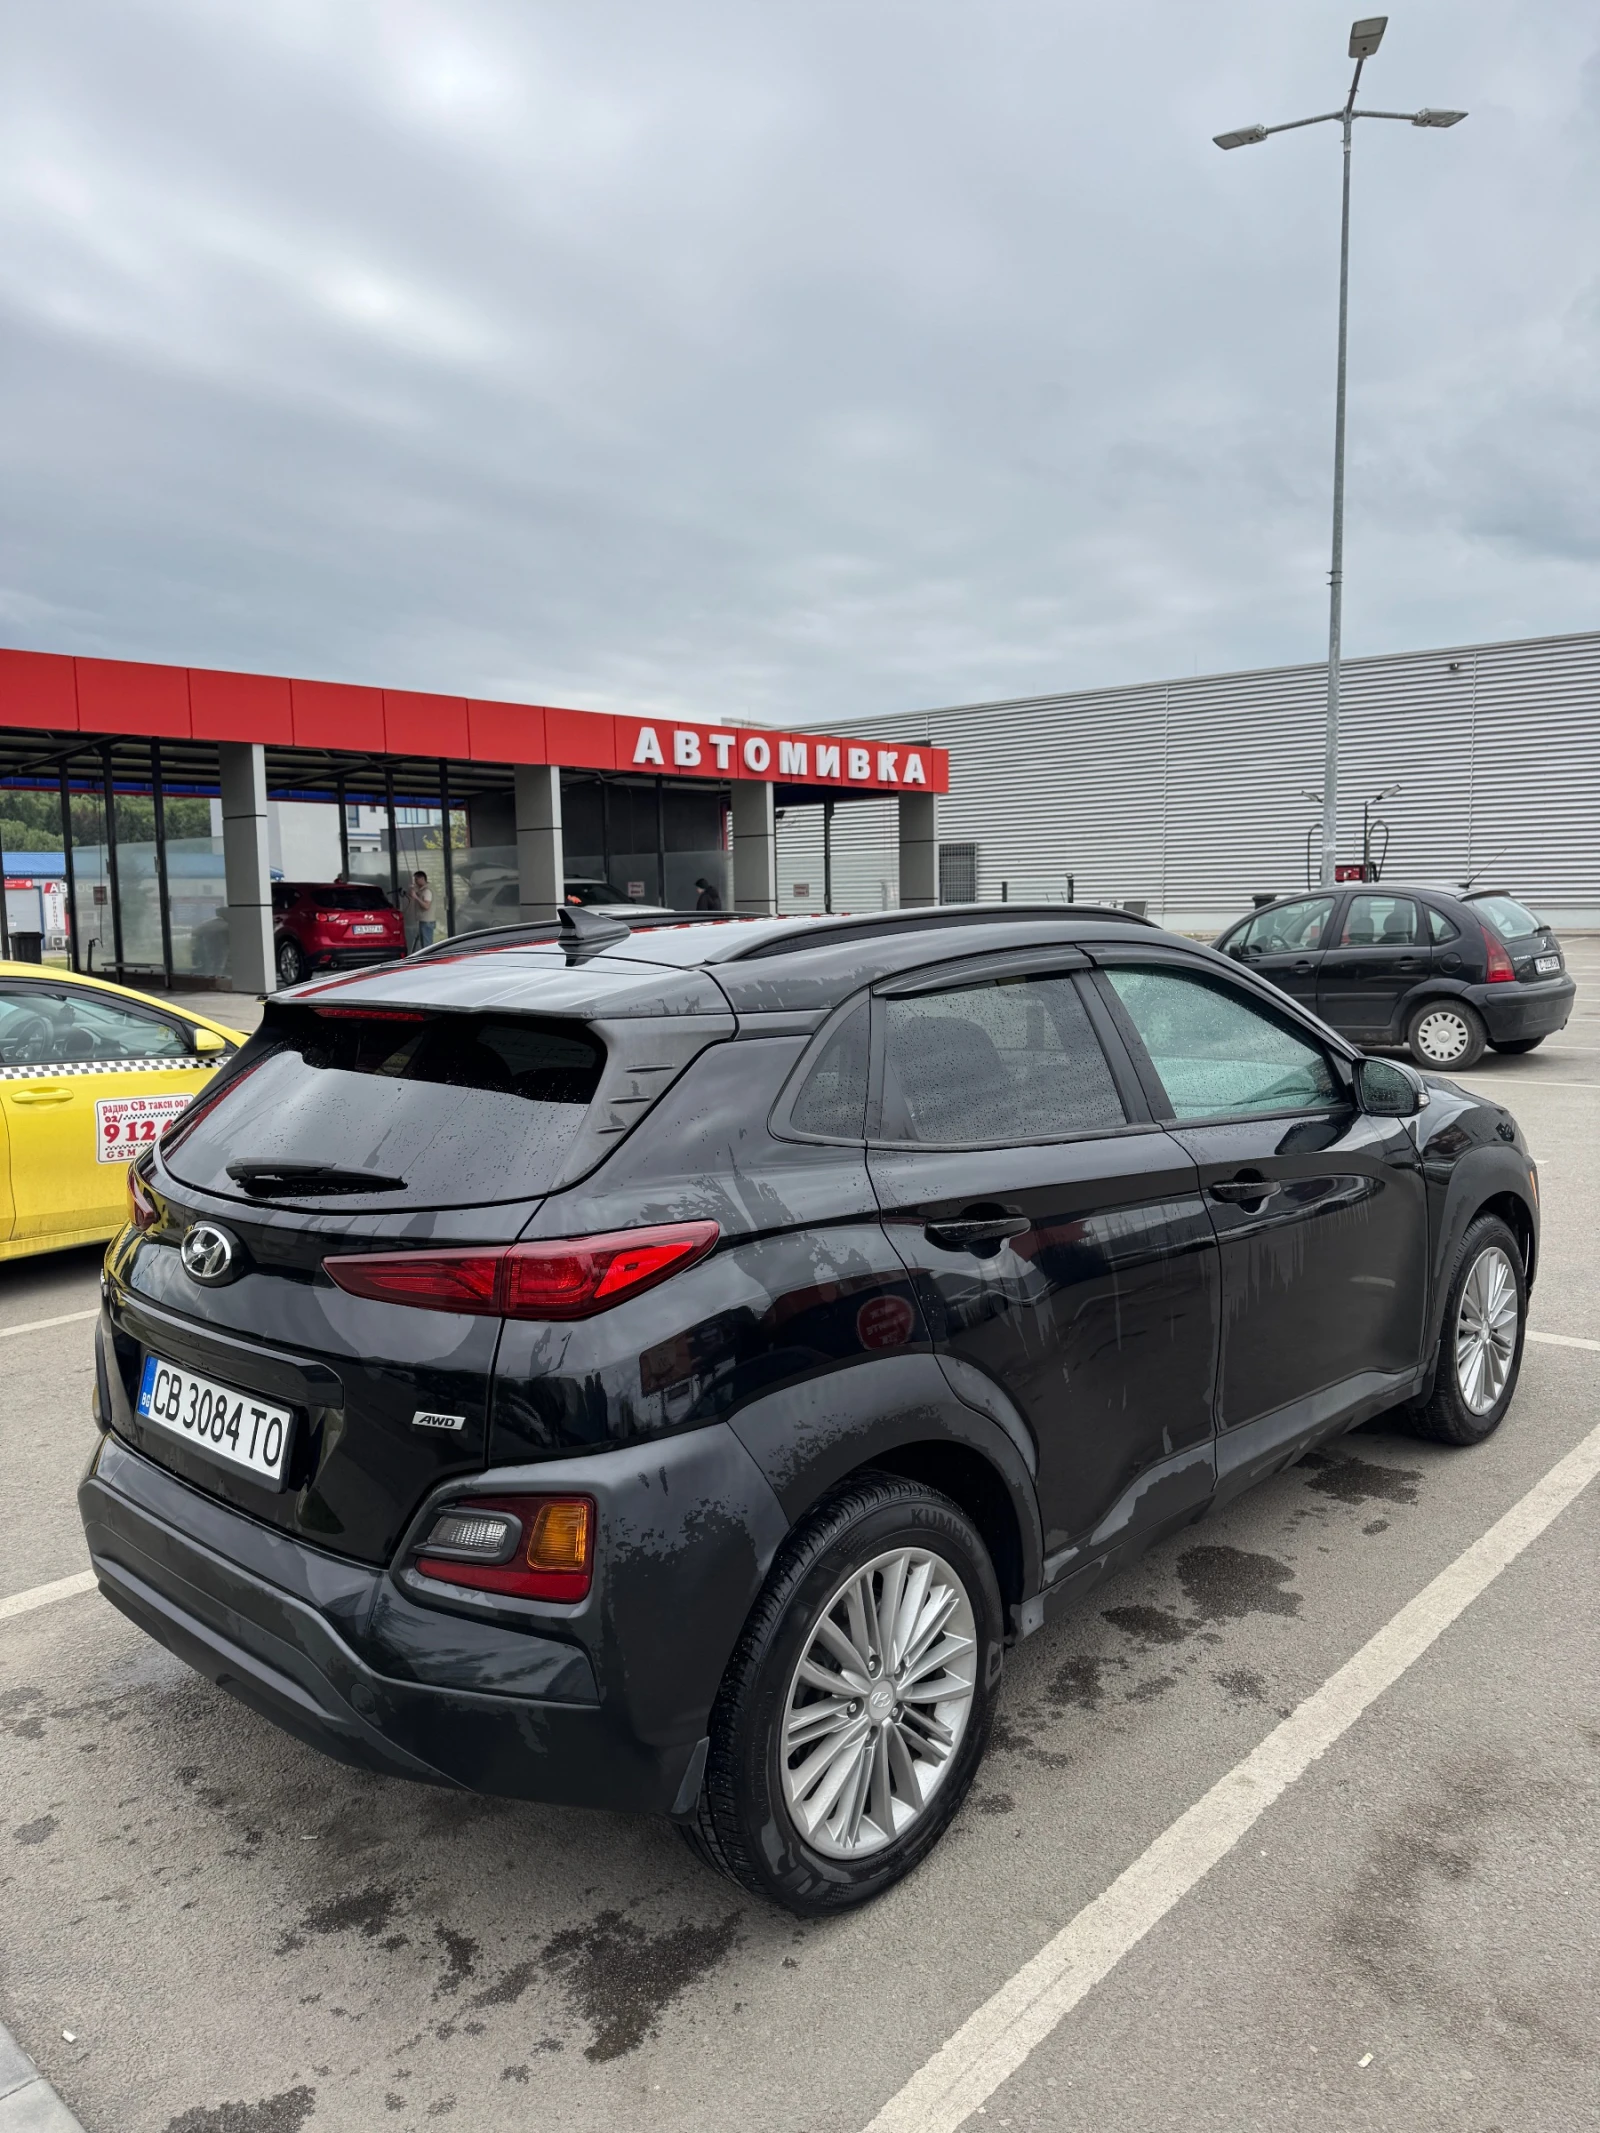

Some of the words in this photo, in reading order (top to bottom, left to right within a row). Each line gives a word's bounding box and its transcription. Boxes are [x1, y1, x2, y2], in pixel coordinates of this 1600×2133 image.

[632, 727, 926, 784] АВТОМИВКА
[102, 1104, 128, 1116] радио
[130, 1101, 146, 1111] СВ
[148, 1100, 173, 1110] такси
[141, 1392, 150, 1407] BG
[418, 1415, 456, 1427] AWD
[911, 1508, 973, 1547] KUMHO
